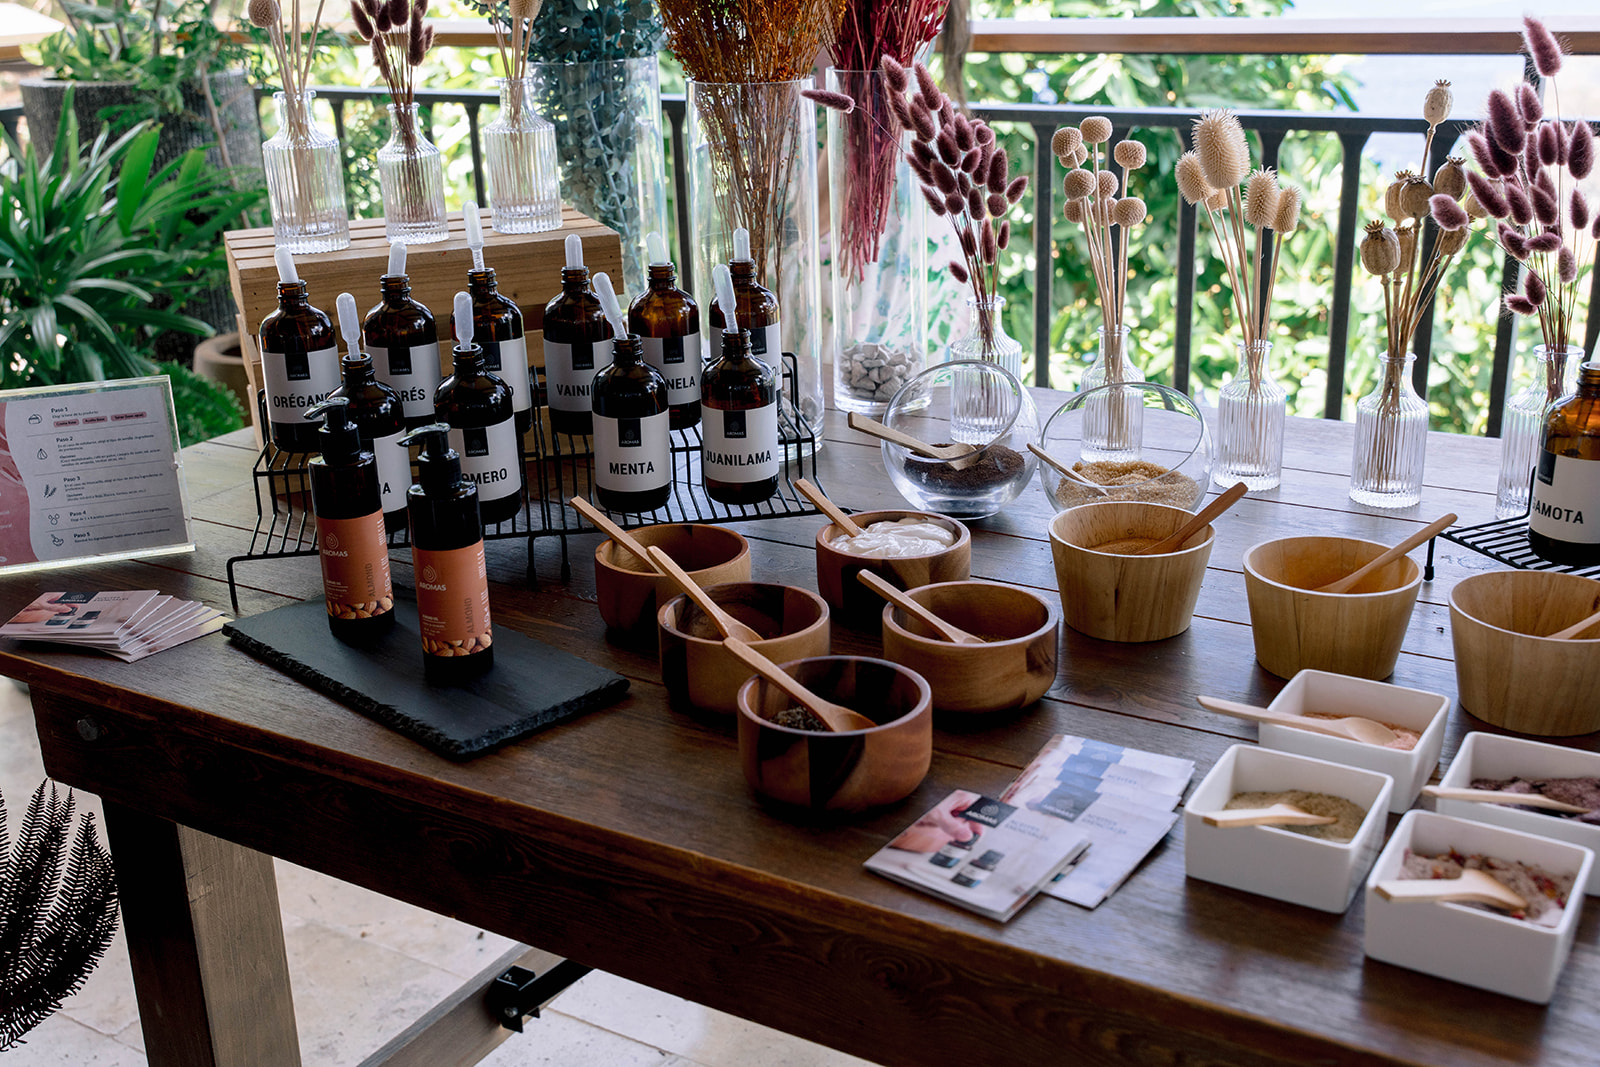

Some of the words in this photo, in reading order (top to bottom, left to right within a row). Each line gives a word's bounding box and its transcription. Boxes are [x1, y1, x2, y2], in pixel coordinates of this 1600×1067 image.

[666, 376, 696, 390] NELA
[556, 384, 590, 397] VAINI
[705, 449, 772, 467] JUANILAMA
[609, 461, 655, 475] MENTA
[461, 468, 507, 485] OMERO
[322, 549, 348, 558] AROMAS
[365, 563, 376, 597] ALMOND
[419, 582, 447, 592] AROMAS
[464, 597, 475, 634] ALMOND
